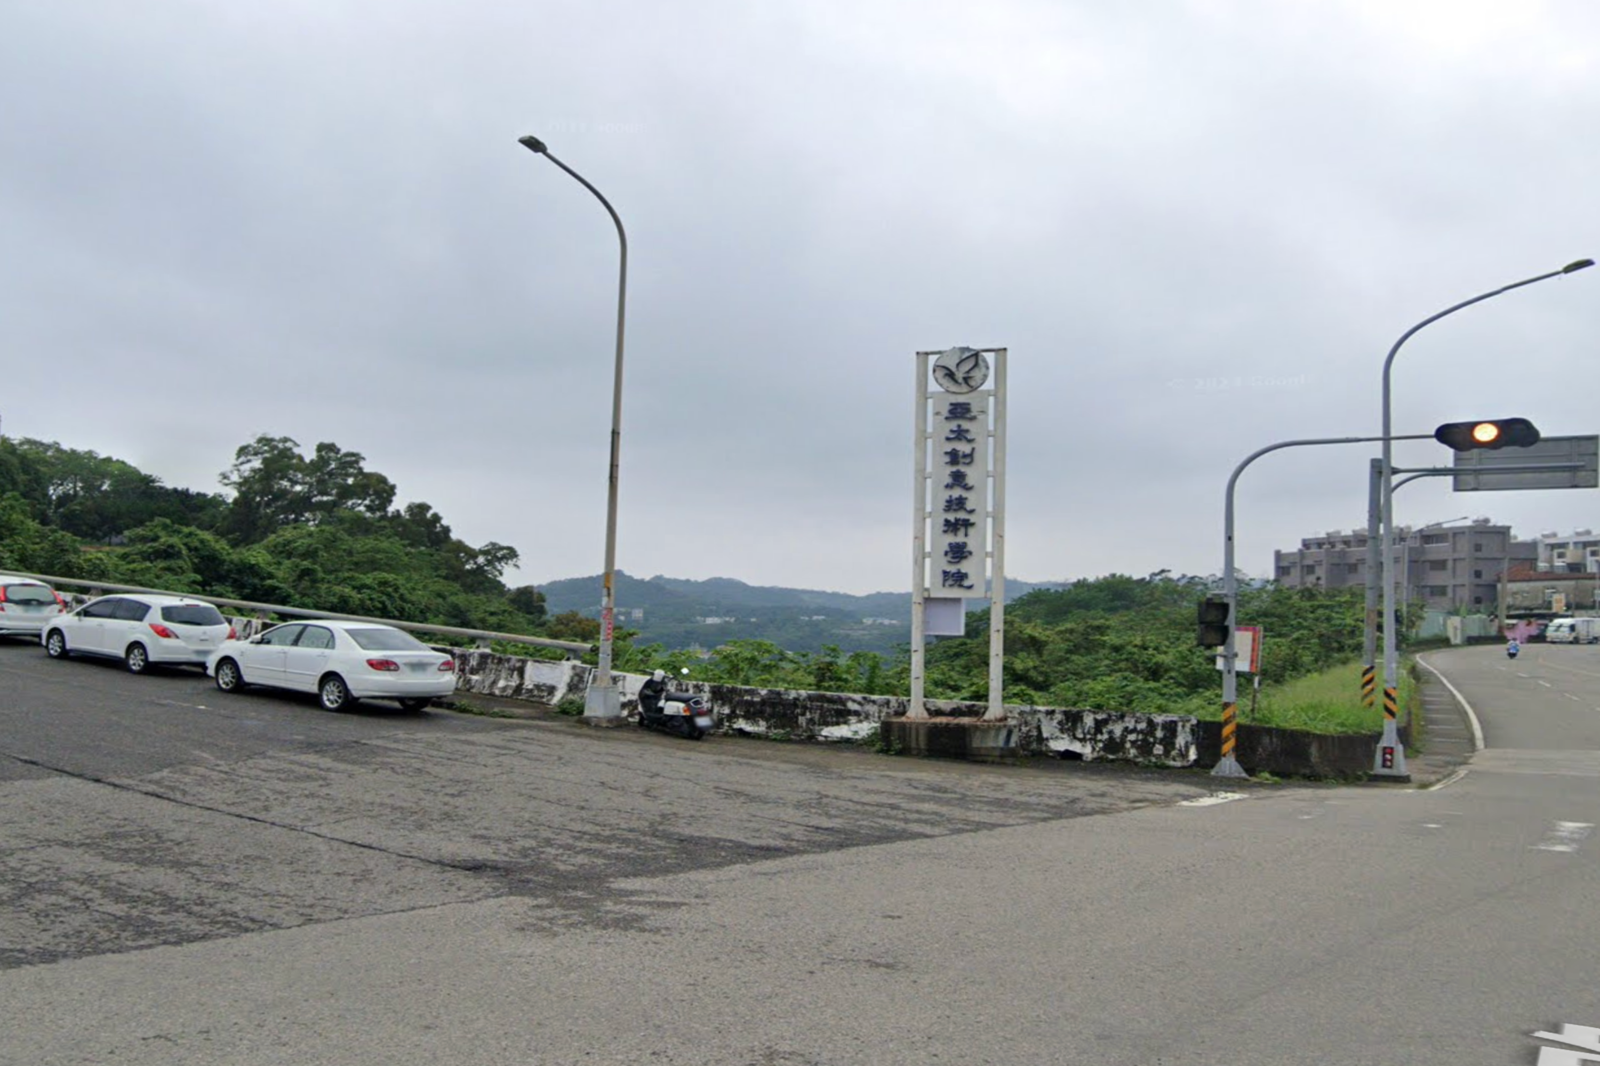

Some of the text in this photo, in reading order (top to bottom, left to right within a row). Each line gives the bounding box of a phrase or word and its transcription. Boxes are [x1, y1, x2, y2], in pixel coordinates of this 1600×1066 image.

[942, 402, 977, 589] 亞太創意技術學院
